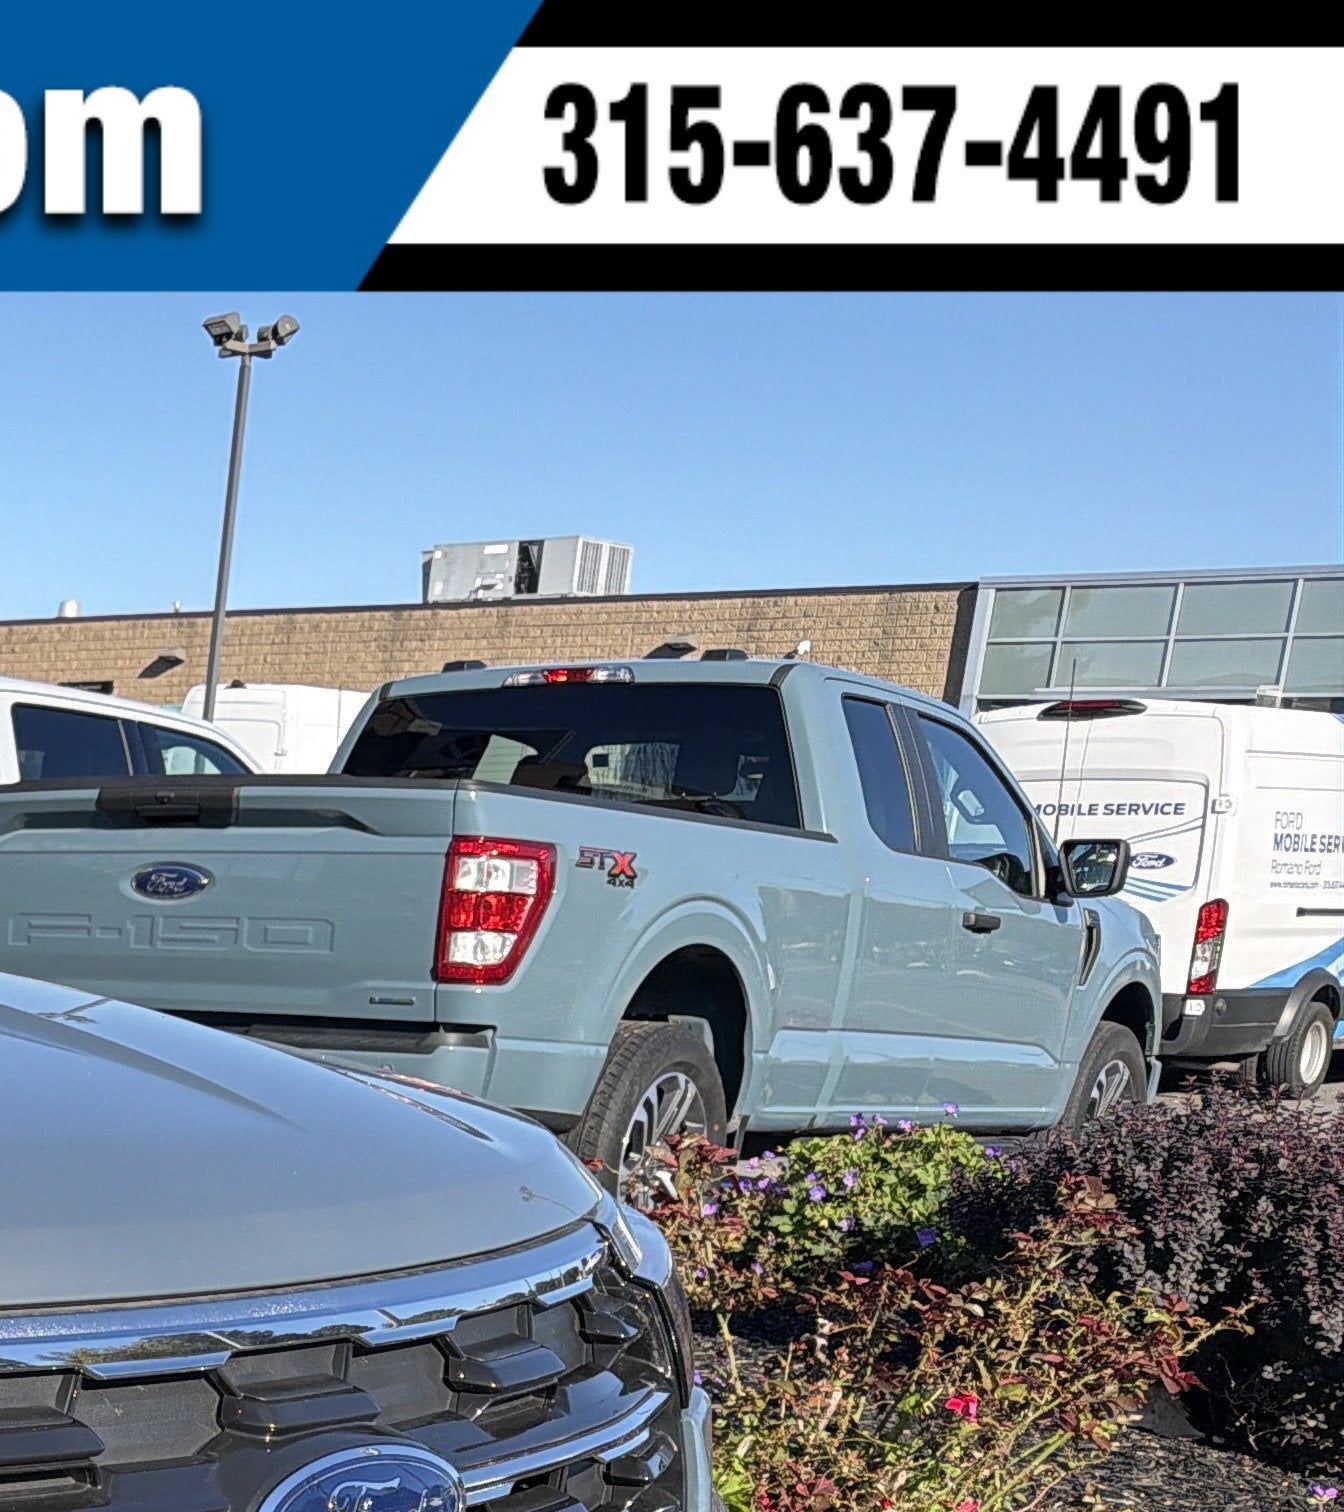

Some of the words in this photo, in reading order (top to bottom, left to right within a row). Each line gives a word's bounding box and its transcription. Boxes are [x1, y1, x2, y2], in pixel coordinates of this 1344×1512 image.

[1102, 802, 1186, 816] SERVICE
[1273, 833, 1317, 852] MOBILE
[1319, 834, 1344, 853] SER
[575, 846, 638, 879] STX
[607, 878, 634, 889] 4x4
[8, 912, 335, 953] F-150
